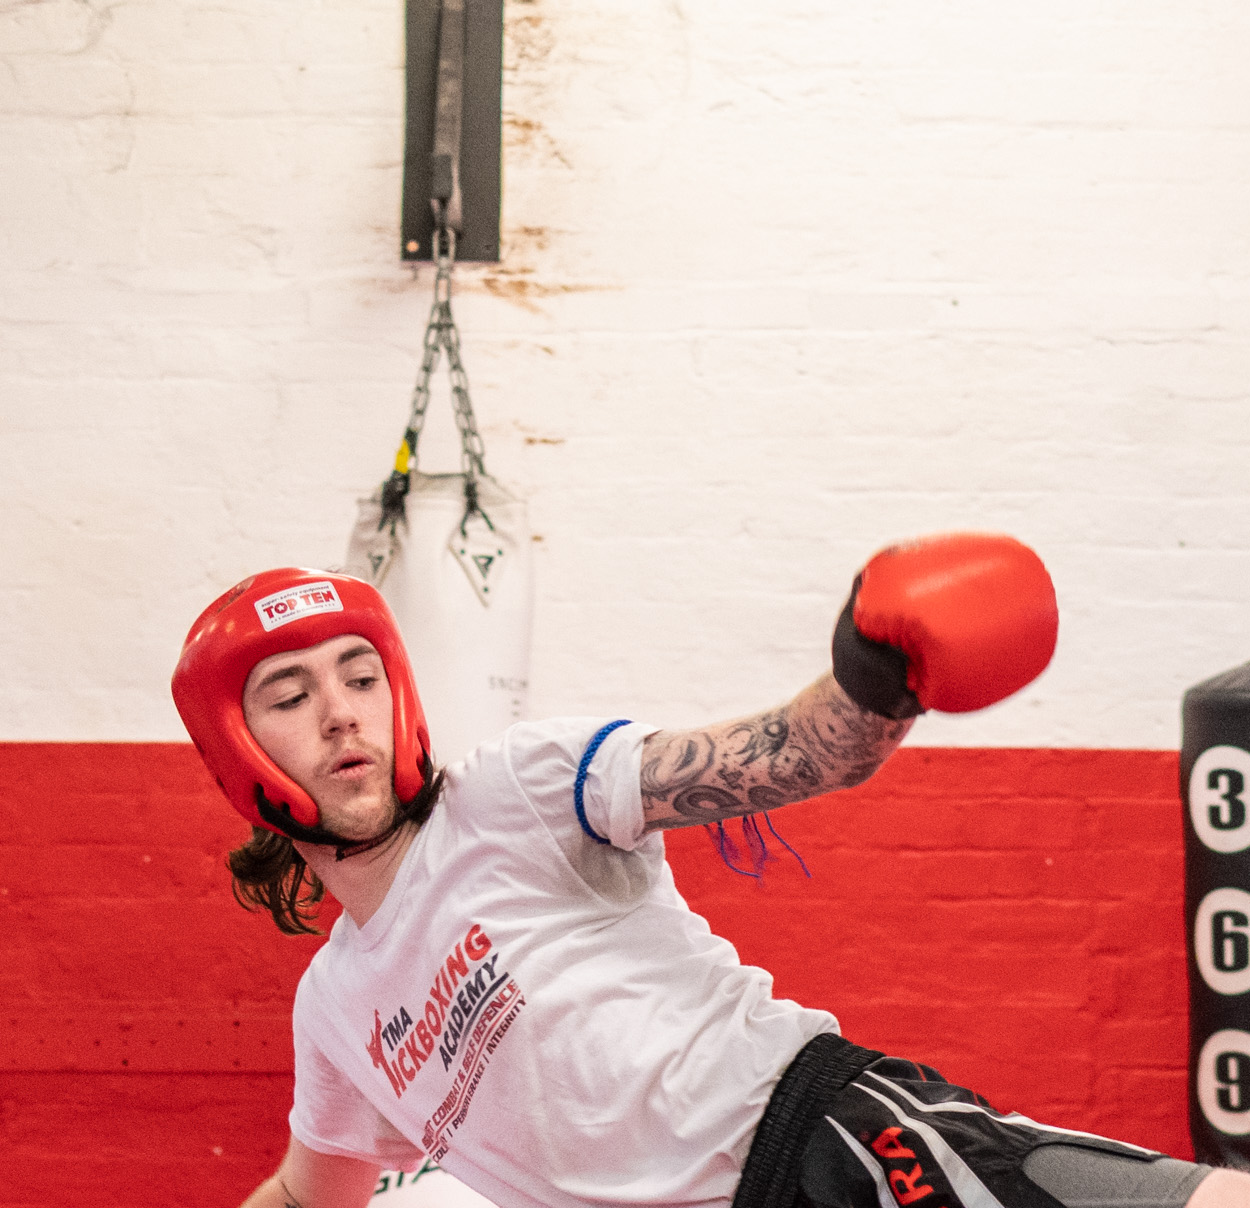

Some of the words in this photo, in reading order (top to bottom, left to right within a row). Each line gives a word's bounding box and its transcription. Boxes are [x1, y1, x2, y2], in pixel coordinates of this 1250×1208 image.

[263, 598, 298, 619] TOP
[300, 591, 335, 606] TEN
[1206, 768, 1247, 831] 3
[1210, 910, 1250, 973] 6
[381, 1005, 414, 1052] TMA
[438, 952, 499, 1073] ACADEMY
[472, 979, 519, 1045] DEFENCE
[486, 995, 527, 1055] INTEGRITY
